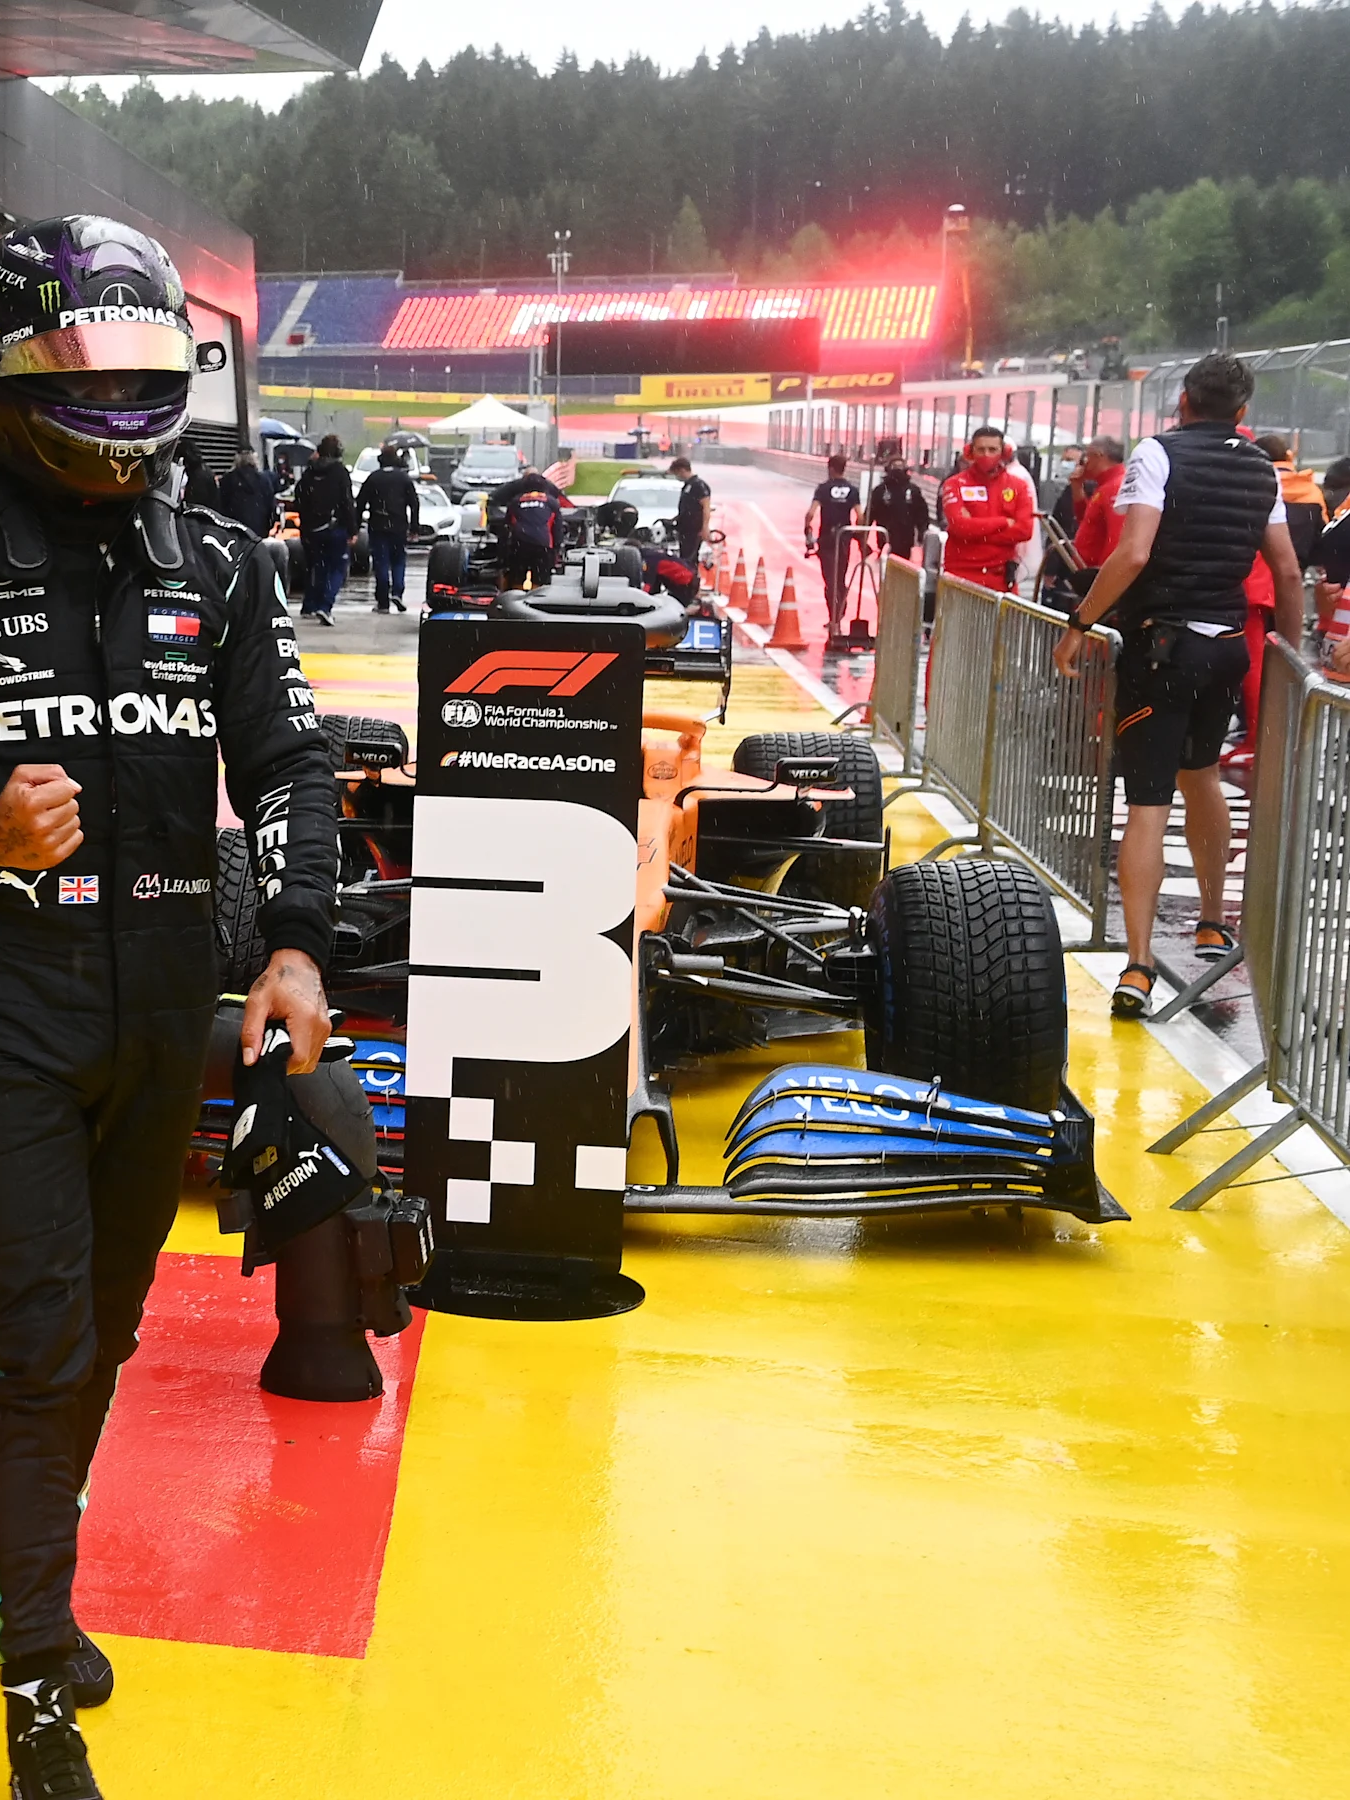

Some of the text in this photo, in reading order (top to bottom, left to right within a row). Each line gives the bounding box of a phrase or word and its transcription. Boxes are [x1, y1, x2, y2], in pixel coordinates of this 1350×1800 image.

[60, 305, 177, 329] PETRONAS
[2, 325, 34, 345] EPSON
[665, 380, 745, 398] PIRELLI
[776, 373, 895, 392] P ZERO
[144, 588, 202, 603] PETRONAS
[1, 612, 49, 637] UBS
[152, 634, 196, 643] HILFIGER
[143, 660, 209, 676] ewlett Packard
[151, 670, 198, 684] Enterprise
[484, 705, 504, 717] FIA
[506, 705, 557, 718] Formula
[557, 707, 565, 718] 1
[287, 712, 319, 732] TIB
[484, 716, 521, 729] World
[521, 717, 609, 731] Championship
[458, 750, 617, 773] #WeRaceAsOne
[132, 873, 162, 899] 44
[263, 1158, 319, 1211] #REFORM
